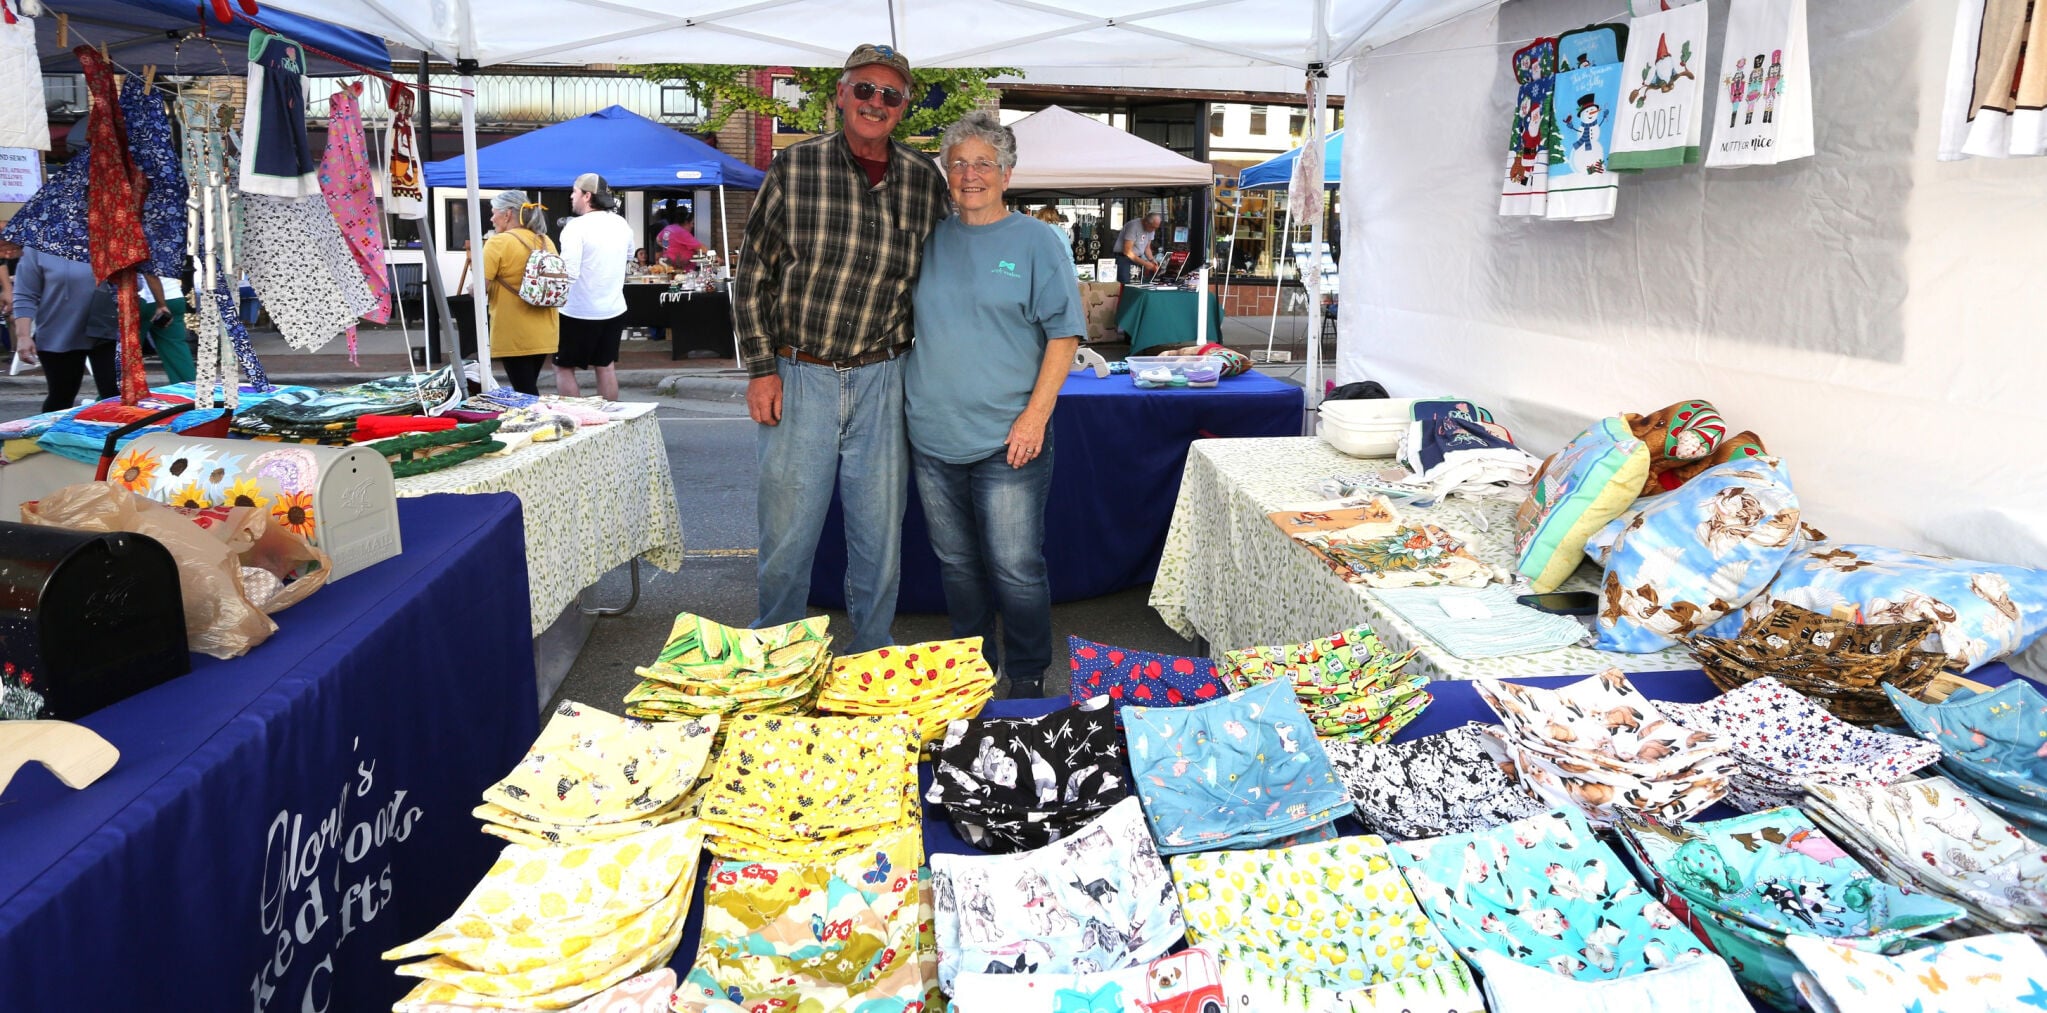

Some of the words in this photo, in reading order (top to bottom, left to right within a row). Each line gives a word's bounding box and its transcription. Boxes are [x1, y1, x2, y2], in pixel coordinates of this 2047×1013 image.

[1631, 104, 1682, 142] GNOEL
[1750, 134, 1775, 150] nice
[334, 789, 425, 892] oods
